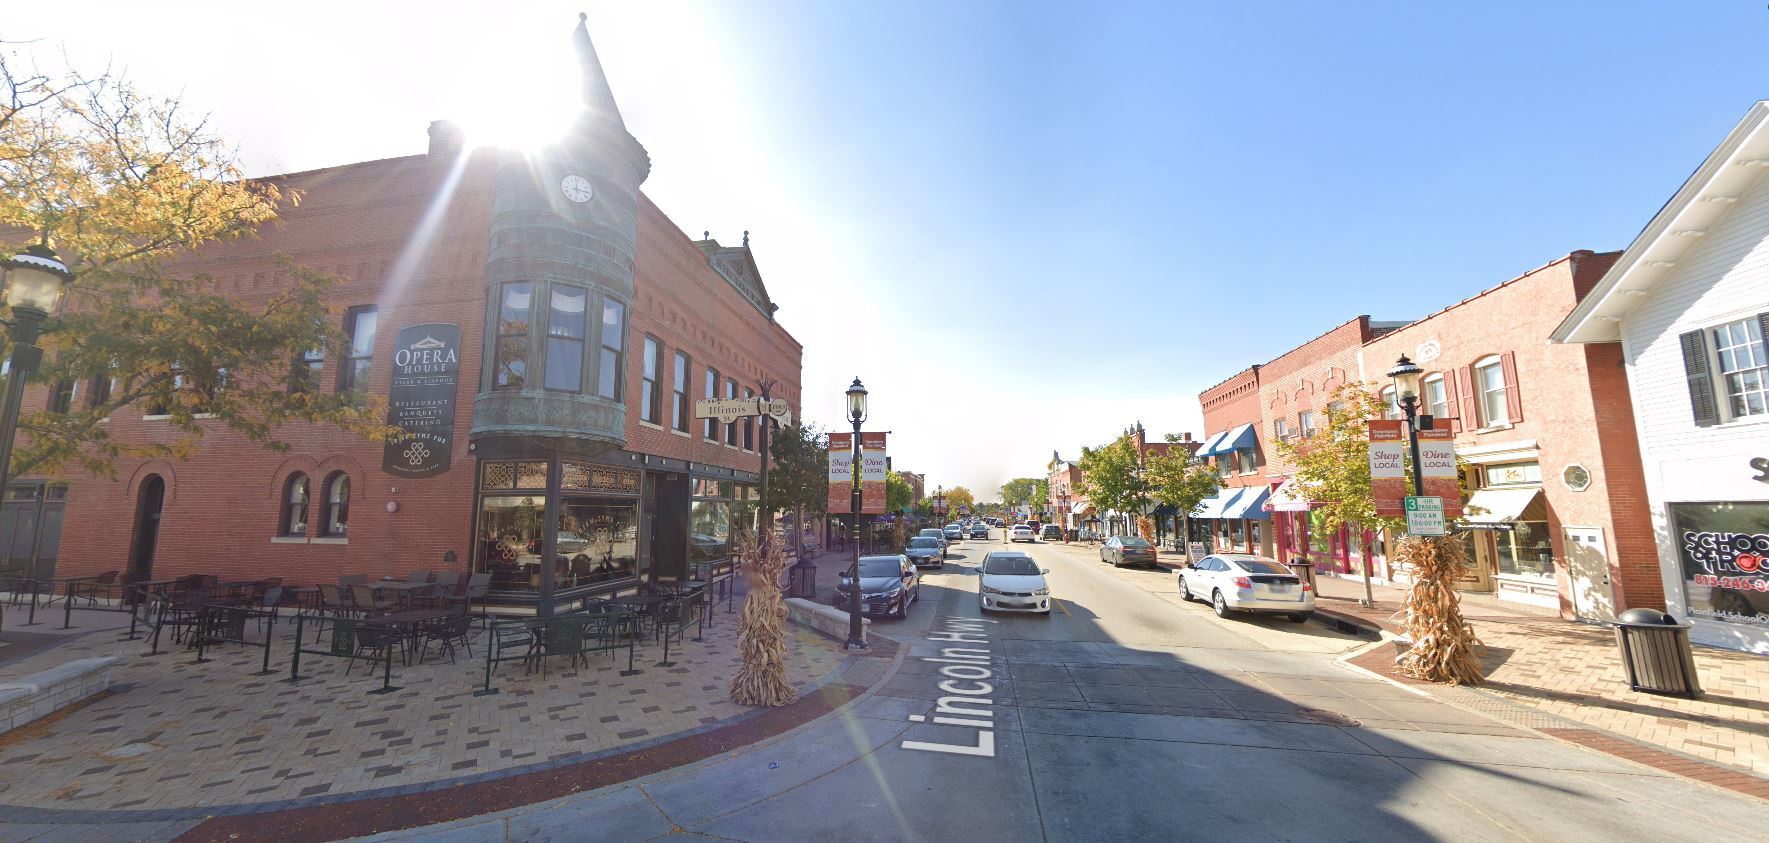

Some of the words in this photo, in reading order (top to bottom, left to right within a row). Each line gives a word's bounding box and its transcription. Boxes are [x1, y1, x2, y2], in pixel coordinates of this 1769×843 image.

[395, 348, 456, 366] OPERA
[404, 363, 446, 374] HOUSE
[709, 405, 746, 414] Illinois
[1374, 451, 1400, 462] Shop
[1422, 450, 1450, 459] Dine
[831, 459, 850, 467] Shop
[1408, 499, 1417, 510] 3
[1693, 574, 1769, 592] 815-246-3
